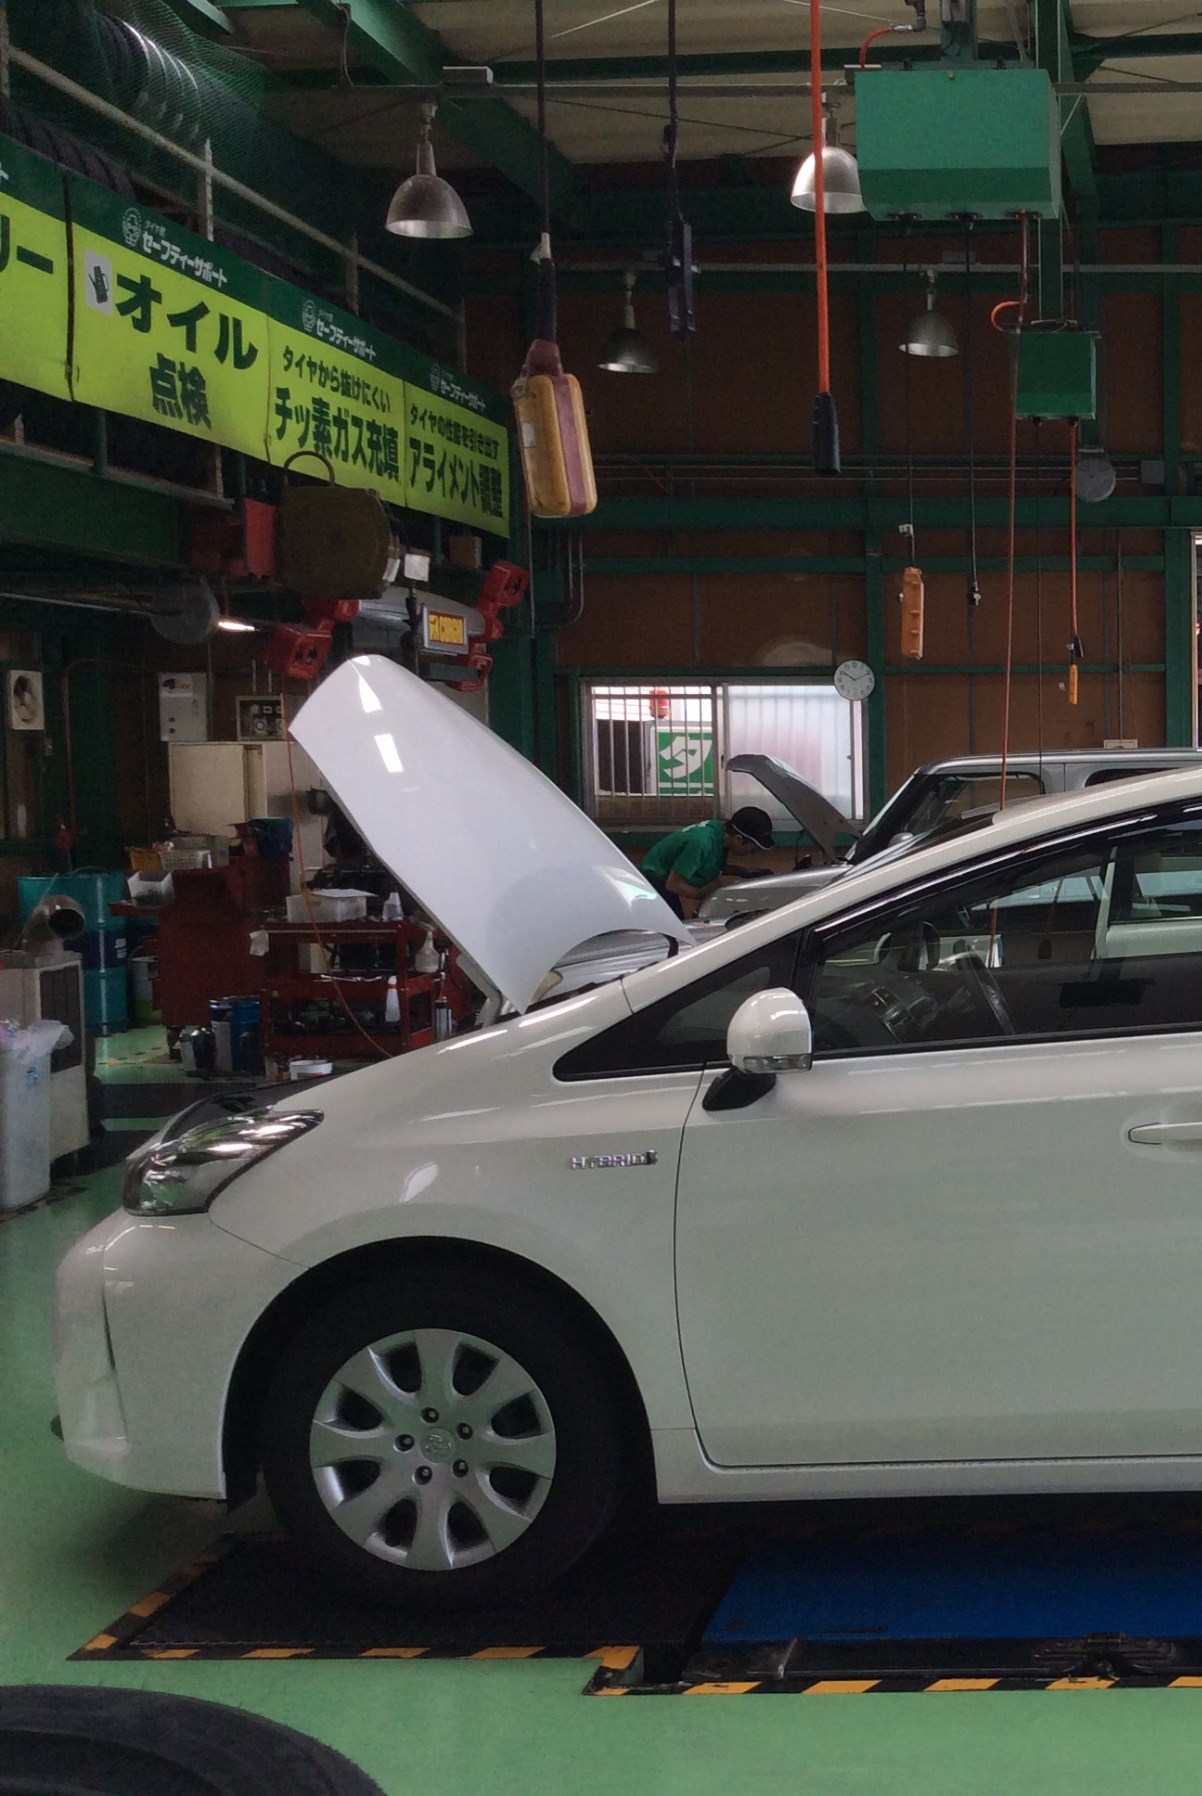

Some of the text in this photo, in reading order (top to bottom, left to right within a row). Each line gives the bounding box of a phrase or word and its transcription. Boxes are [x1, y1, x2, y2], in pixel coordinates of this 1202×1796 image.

[142, 231, 228, 288] セーフティーサポート
[115, 273, 259, 370] オイル
[316, 318, 377, 362] セーフティーサポート
[149, 352, 213, 431] 点検
[282, 345, 392, 414] タイヤから抜けにくい
[275, 386, 400, 484] チッ素ガス充填
